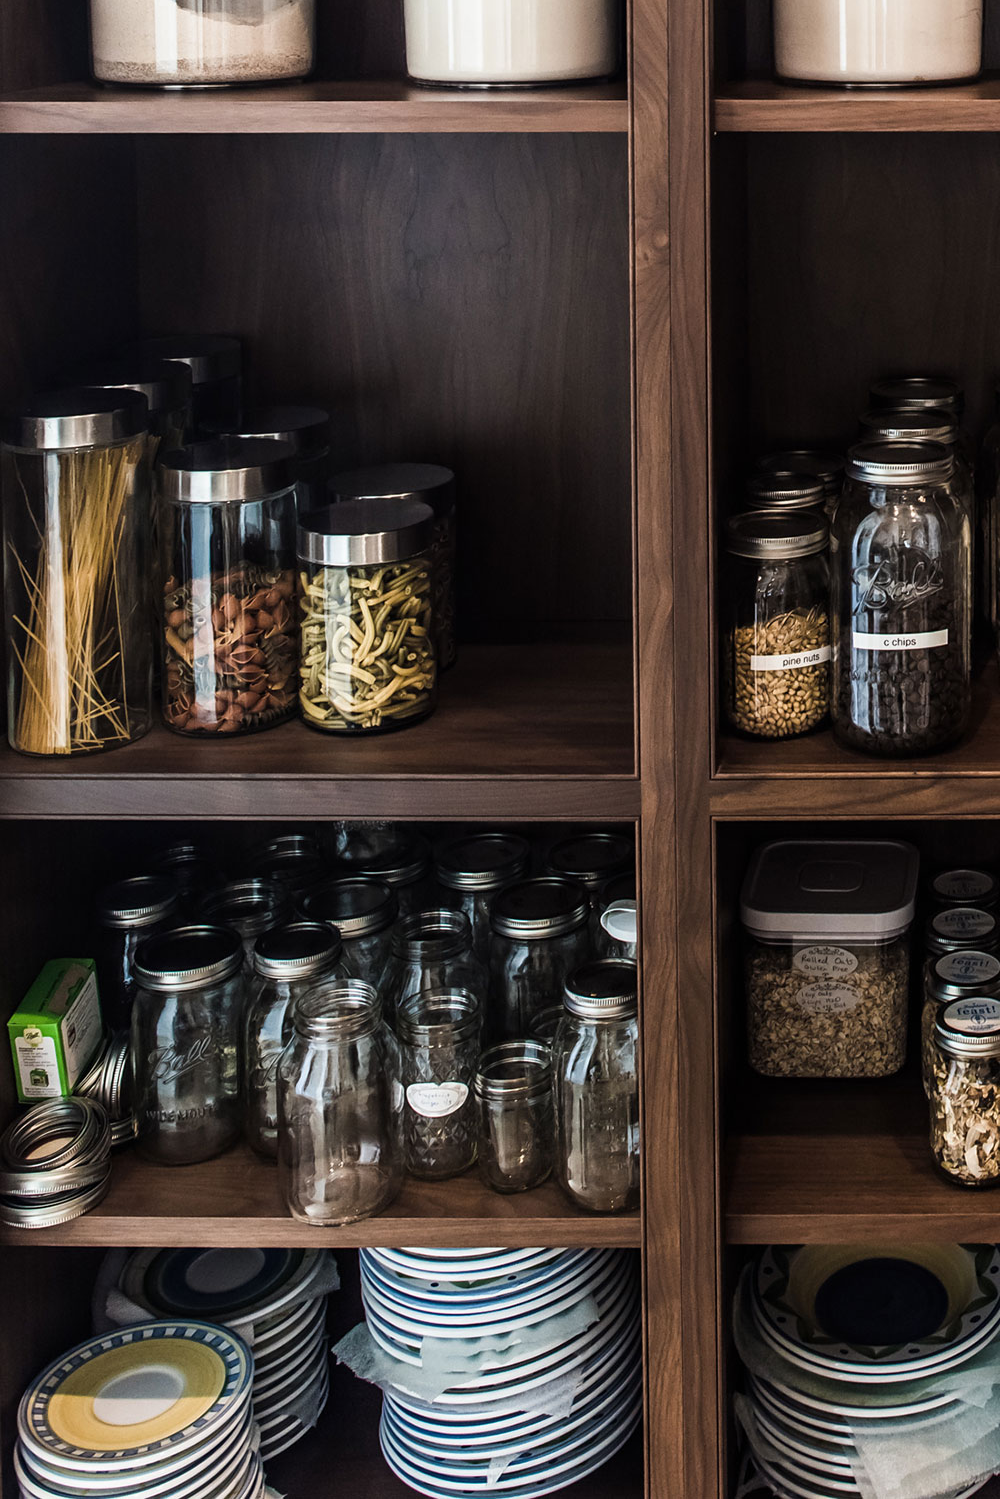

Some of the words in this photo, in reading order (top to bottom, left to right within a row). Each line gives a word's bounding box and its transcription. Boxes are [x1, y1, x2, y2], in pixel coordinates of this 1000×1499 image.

[892, 638, 916, 648] chips
[783, 658, 801, 667] pine
[803, 653, 820, 663] nuts
[801, 954, 828, 963] Rolled
[952, 958, 990, 967] feast!
[956, 1006, 996, 1015] feast!
[26, 1032, 39, 1040] Ball
[148, 1035, 211, 1084] Ball
